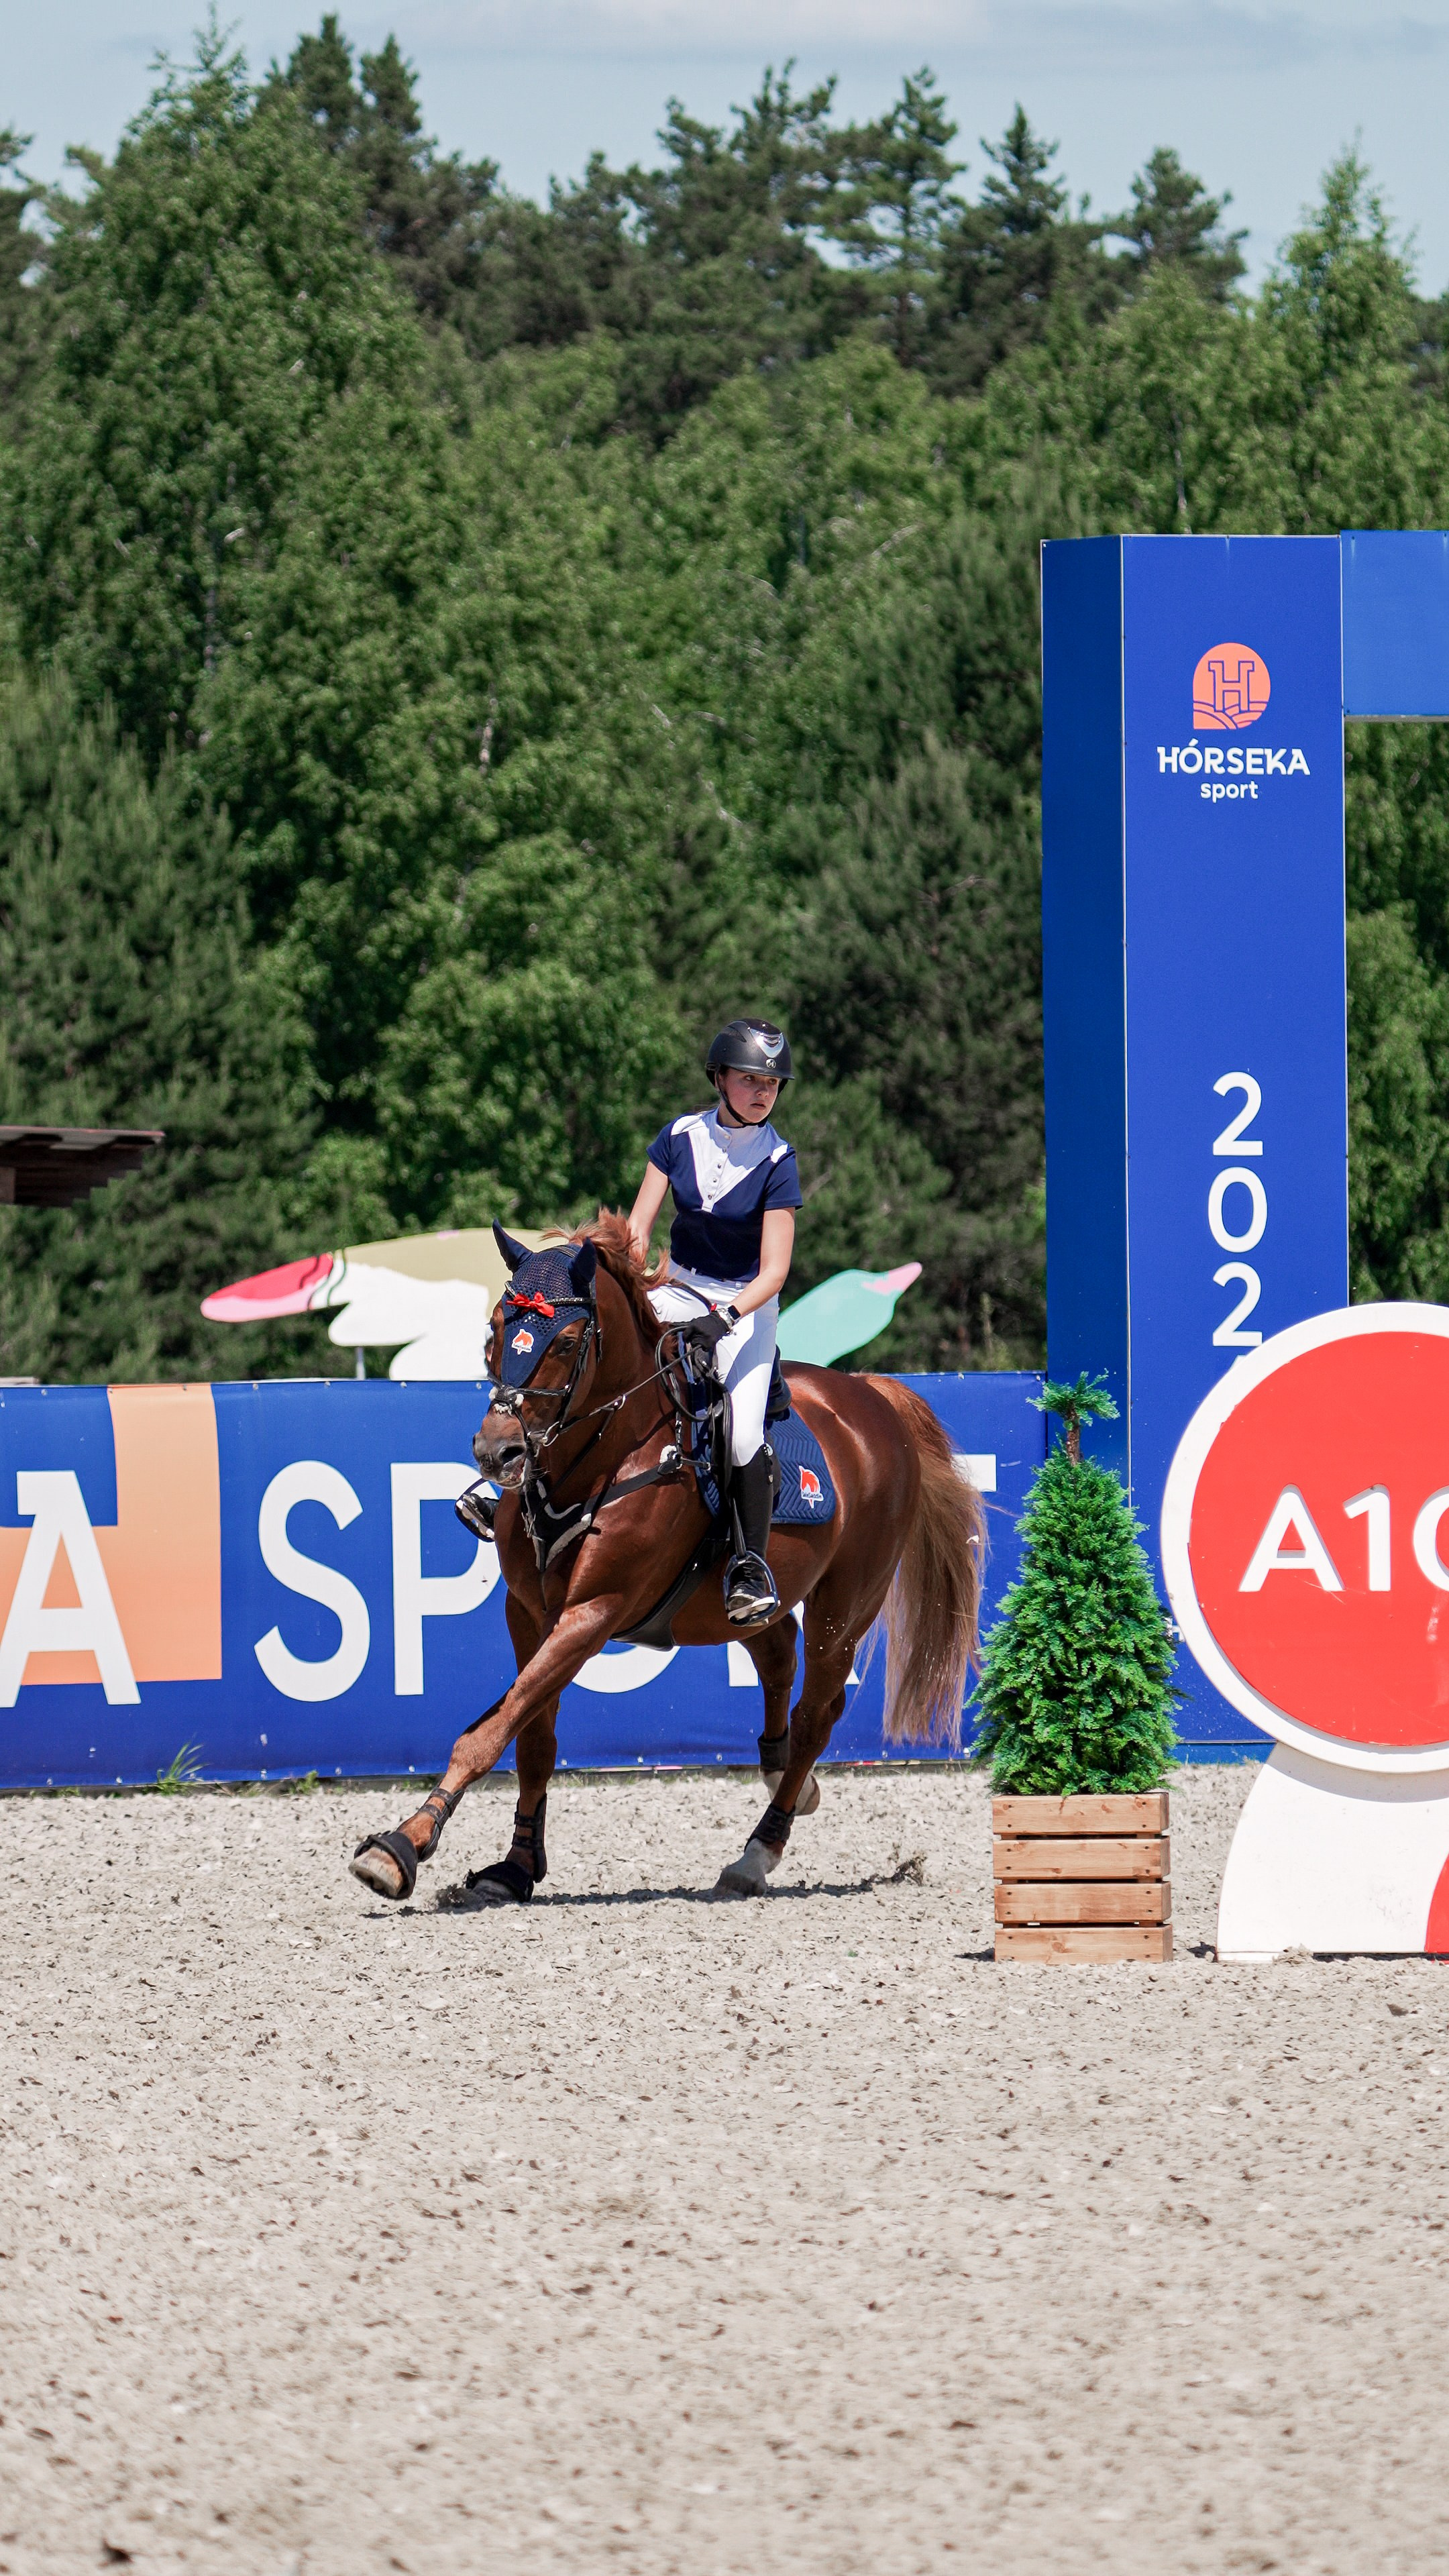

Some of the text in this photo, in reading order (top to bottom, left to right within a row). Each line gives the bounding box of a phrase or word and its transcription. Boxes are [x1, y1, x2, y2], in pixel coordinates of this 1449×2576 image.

[1157, 739, 1310, 775] HÓRSEKA
[1200, 781, 1258, 802] sport
[1208, 1072, 1267, 1371] 202
